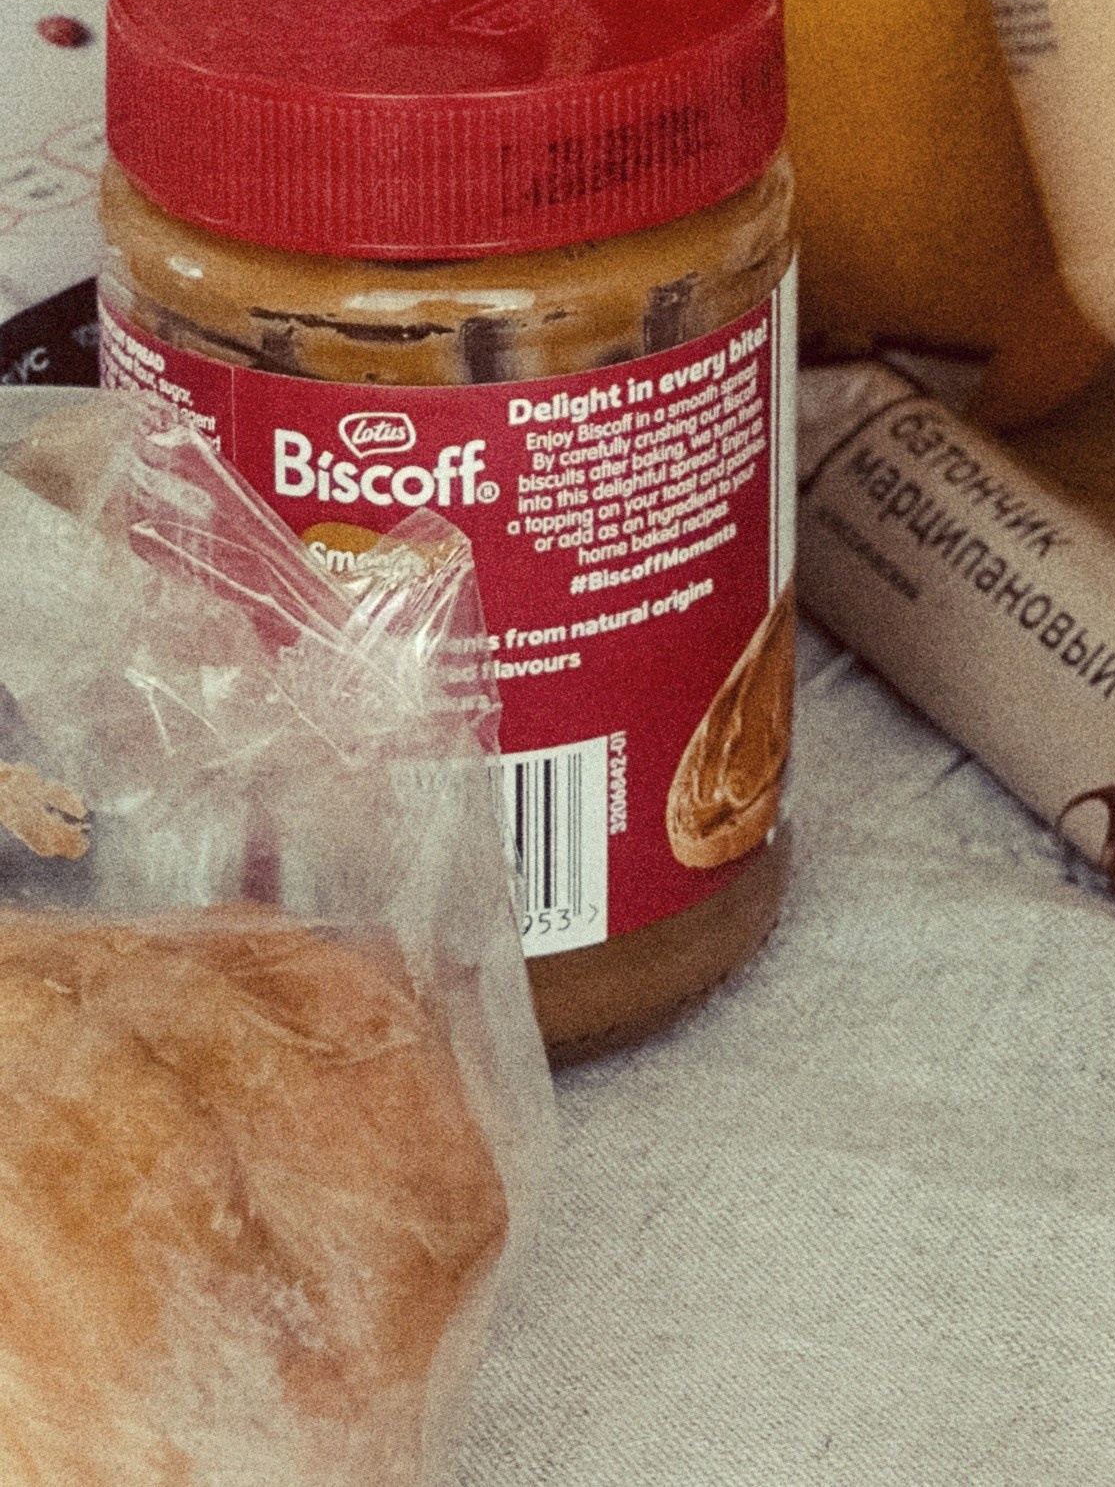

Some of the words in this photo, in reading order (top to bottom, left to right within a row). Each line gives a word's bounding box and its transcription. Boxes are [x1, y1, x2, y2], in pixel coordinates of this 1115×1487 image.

[508, 384, 622, 425] Delight
[627, 377, 653, 405] in
[659, 350, 726, 394] every
[729, 318, 768, 364] bite!
[518, 468, 585, 494] biscuits
[589, 455, 629, 481] after
[632, 440, 687, 472] baking,
[691, 431, 711, 450] we
[526, 428, 574, 452] Enjoy
[578, 413, 633, 442] Biscoff
[636, 411, 651, 429] in
[654, 407, 665, 422] a
[533, 452, 555, 472] By
[559, 437, 631, 467] carefully
[634, 416, 697, 449] crushing
[700, 402, 721, 423] our
[507, 520, 521, 535] a
[524, 508, 594, 536] topping
[598, 501, 620, 520] on
[624, 489, 660, 517] your
[700, 460, 725, 486] and
[518, 495, 552, 514] into
[557, 488, 588, 508] this
[592, 463, 667, 501] delightful
[534, 536, 554, 553] or
[558, 526, 594, 549] add
[598, 522, 618, 541] as
[622, 518, 644, 535] an
[569, 523, 737, 595] #BiscoffMoments
[579, 540, 628, 566] home
[632, 520, 679, 552] baked
[505, 623, 566, 650] from
[571, 600, 650, 639] natural
[652, 578, 714, 616] origins
